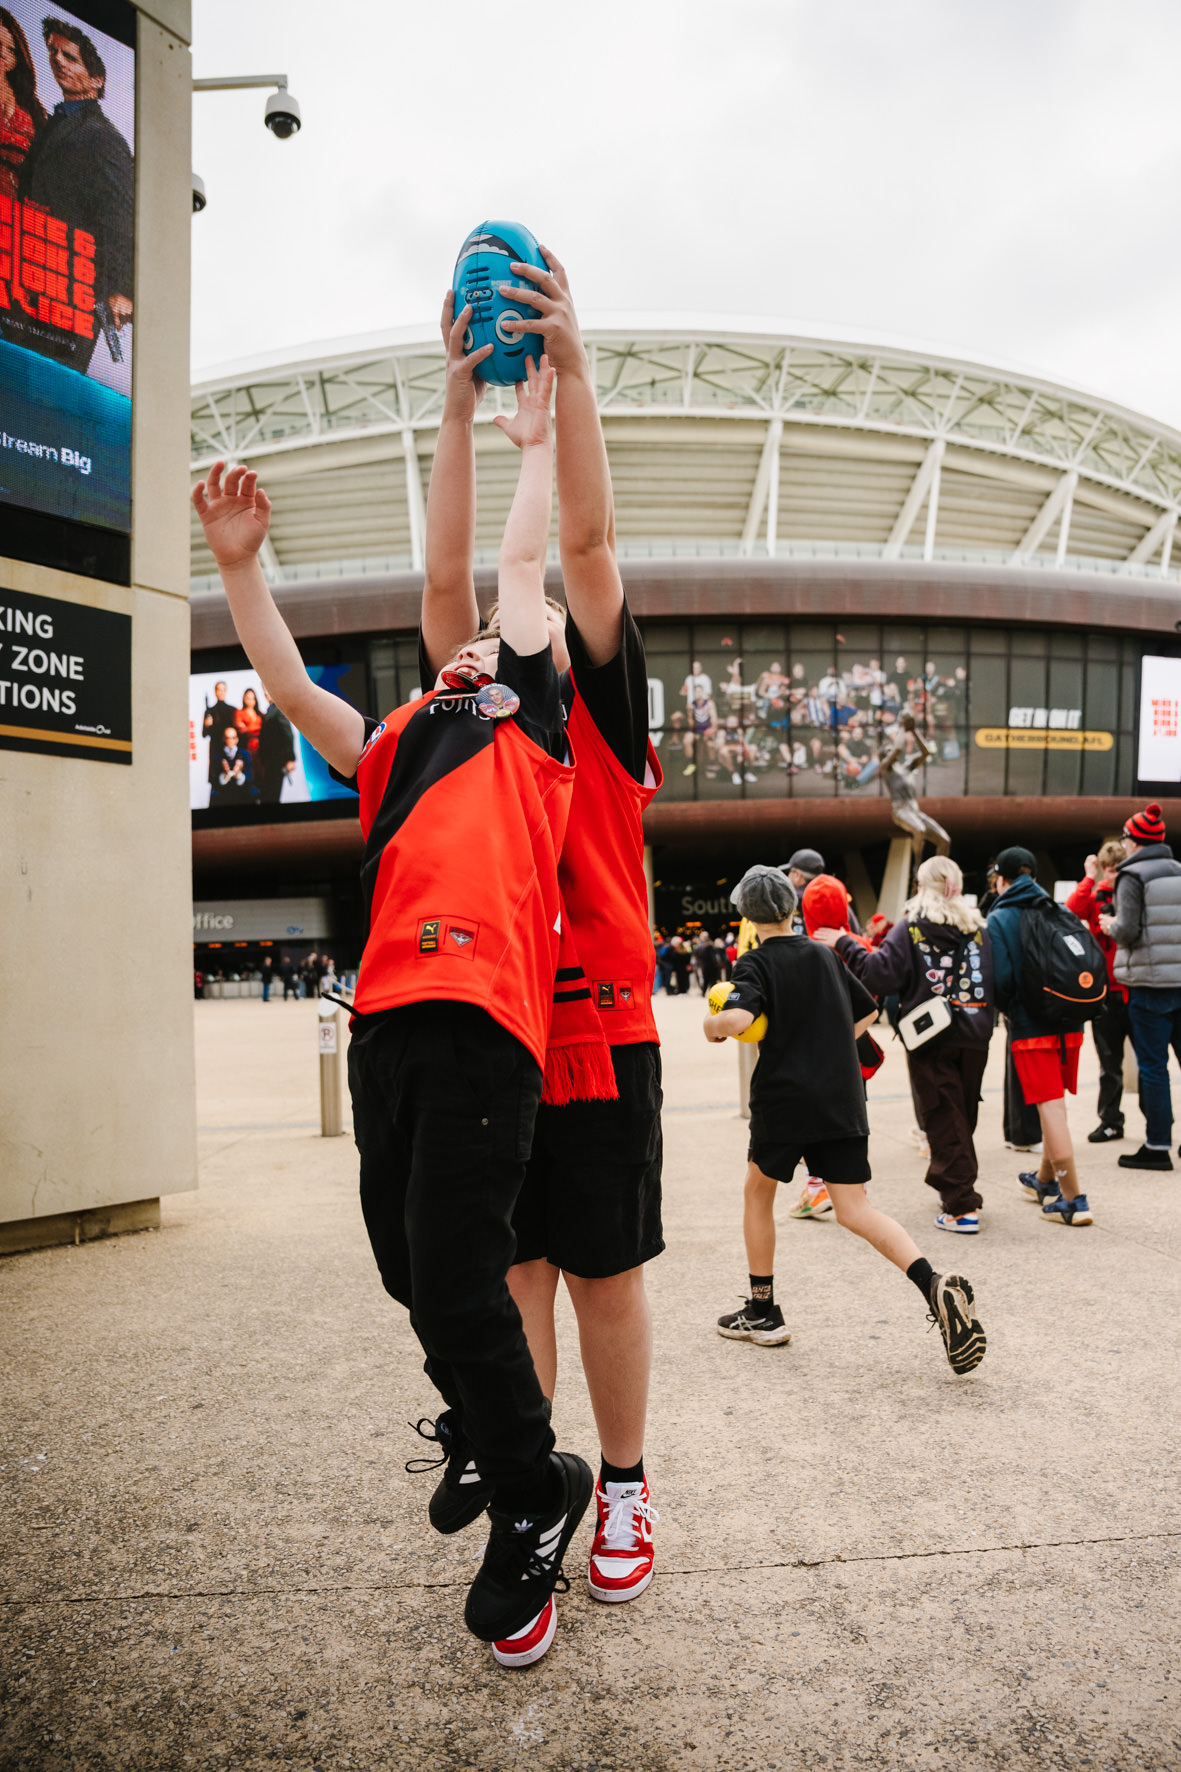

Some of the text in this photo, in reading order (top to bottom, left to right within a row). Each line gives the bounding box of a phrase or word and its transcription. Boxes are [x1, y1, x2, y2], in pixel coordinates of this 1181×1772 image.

[0, 431, 93, 475] tream Big
[11, 645, 84, 681] ZONE
